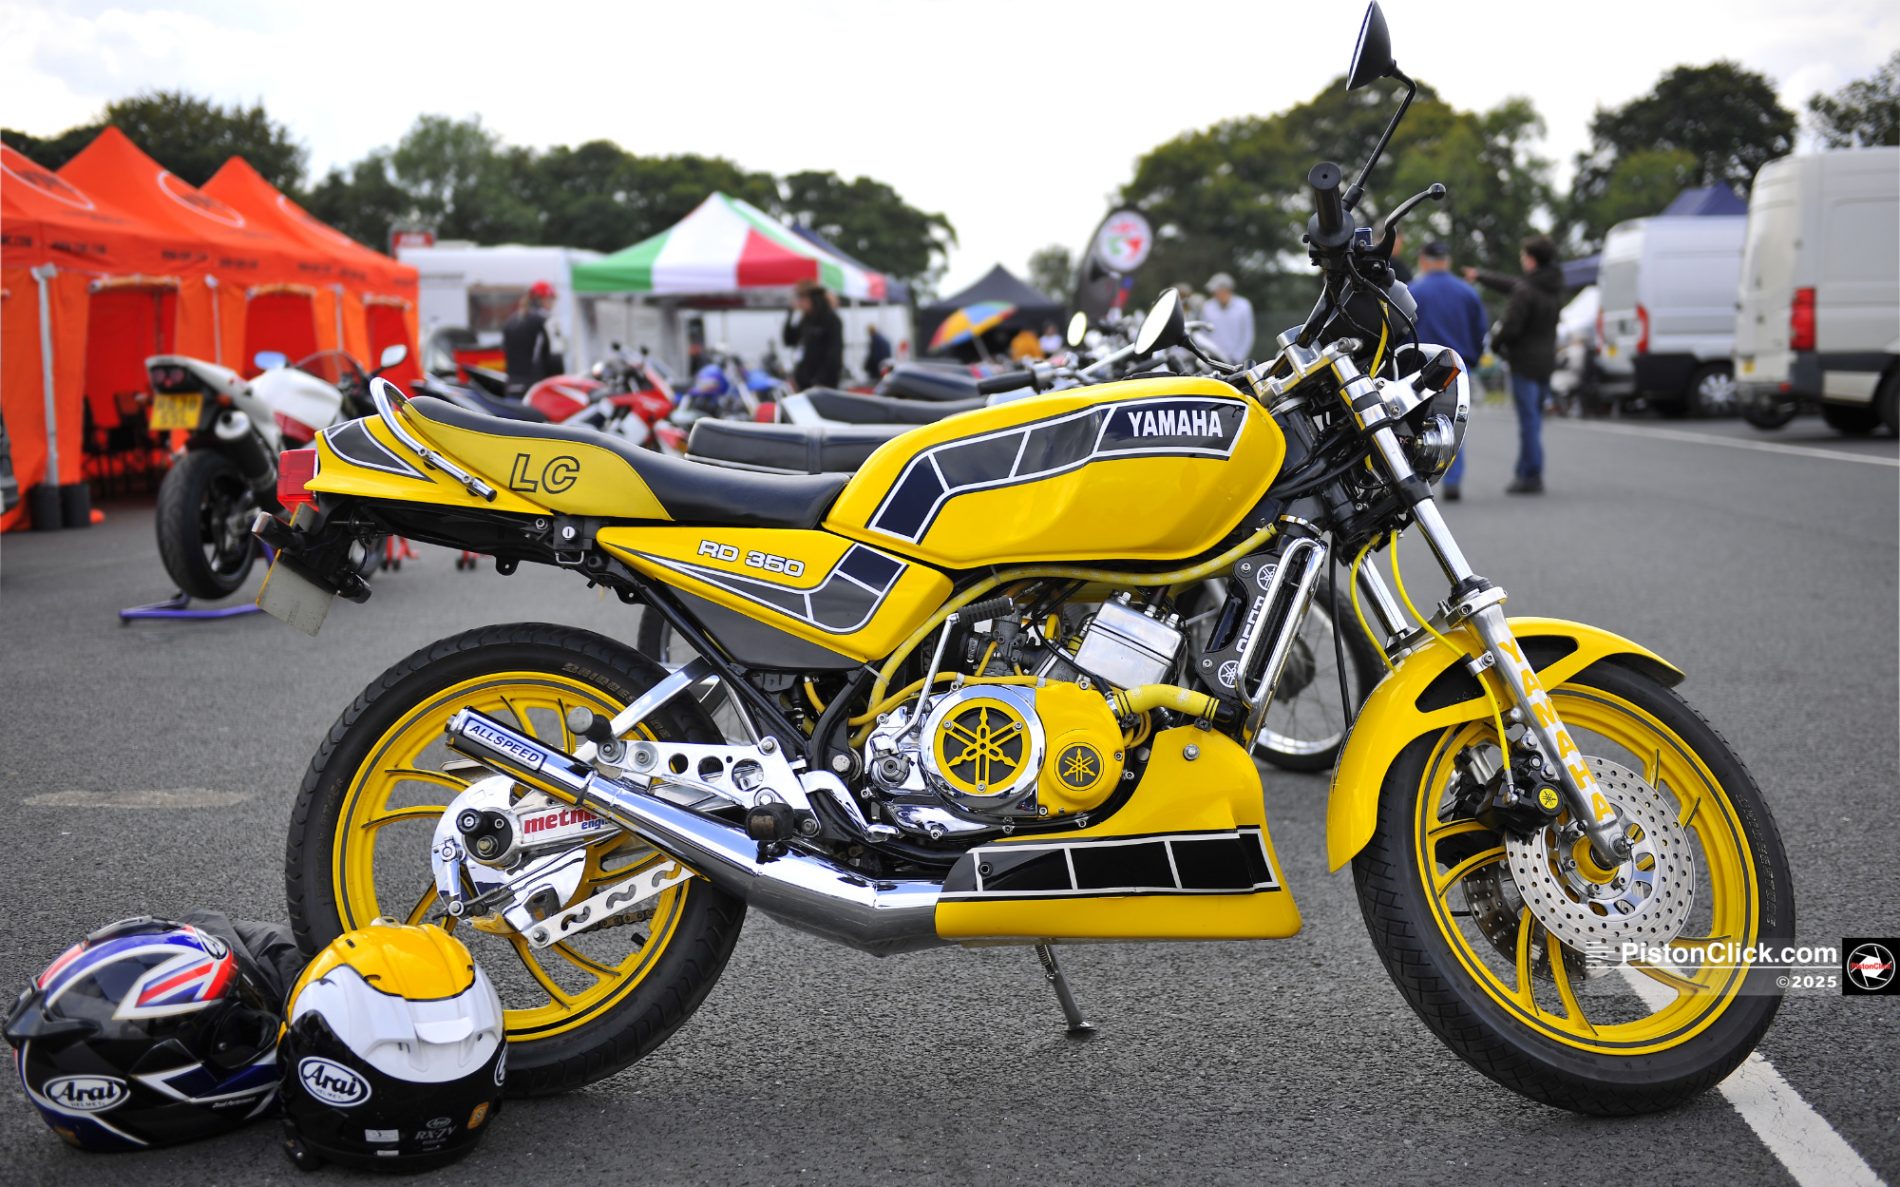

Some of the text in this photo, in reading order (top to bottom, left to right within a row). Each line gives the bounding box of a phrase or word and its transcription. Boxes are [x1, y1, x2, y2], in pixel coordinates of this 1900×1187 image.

[1127, 409, 1223, 437] YAMAHA
[509, 453, 580, 494] LC
[697, 540, 805, 577] RD 350
[469, 724, 540, 763] ALLSPEED
[1497, 637, 1616, 822] YAMAHA
[52, 1081, 118, 1101] Arai
[302, 1064, 358, 1096] Arai
